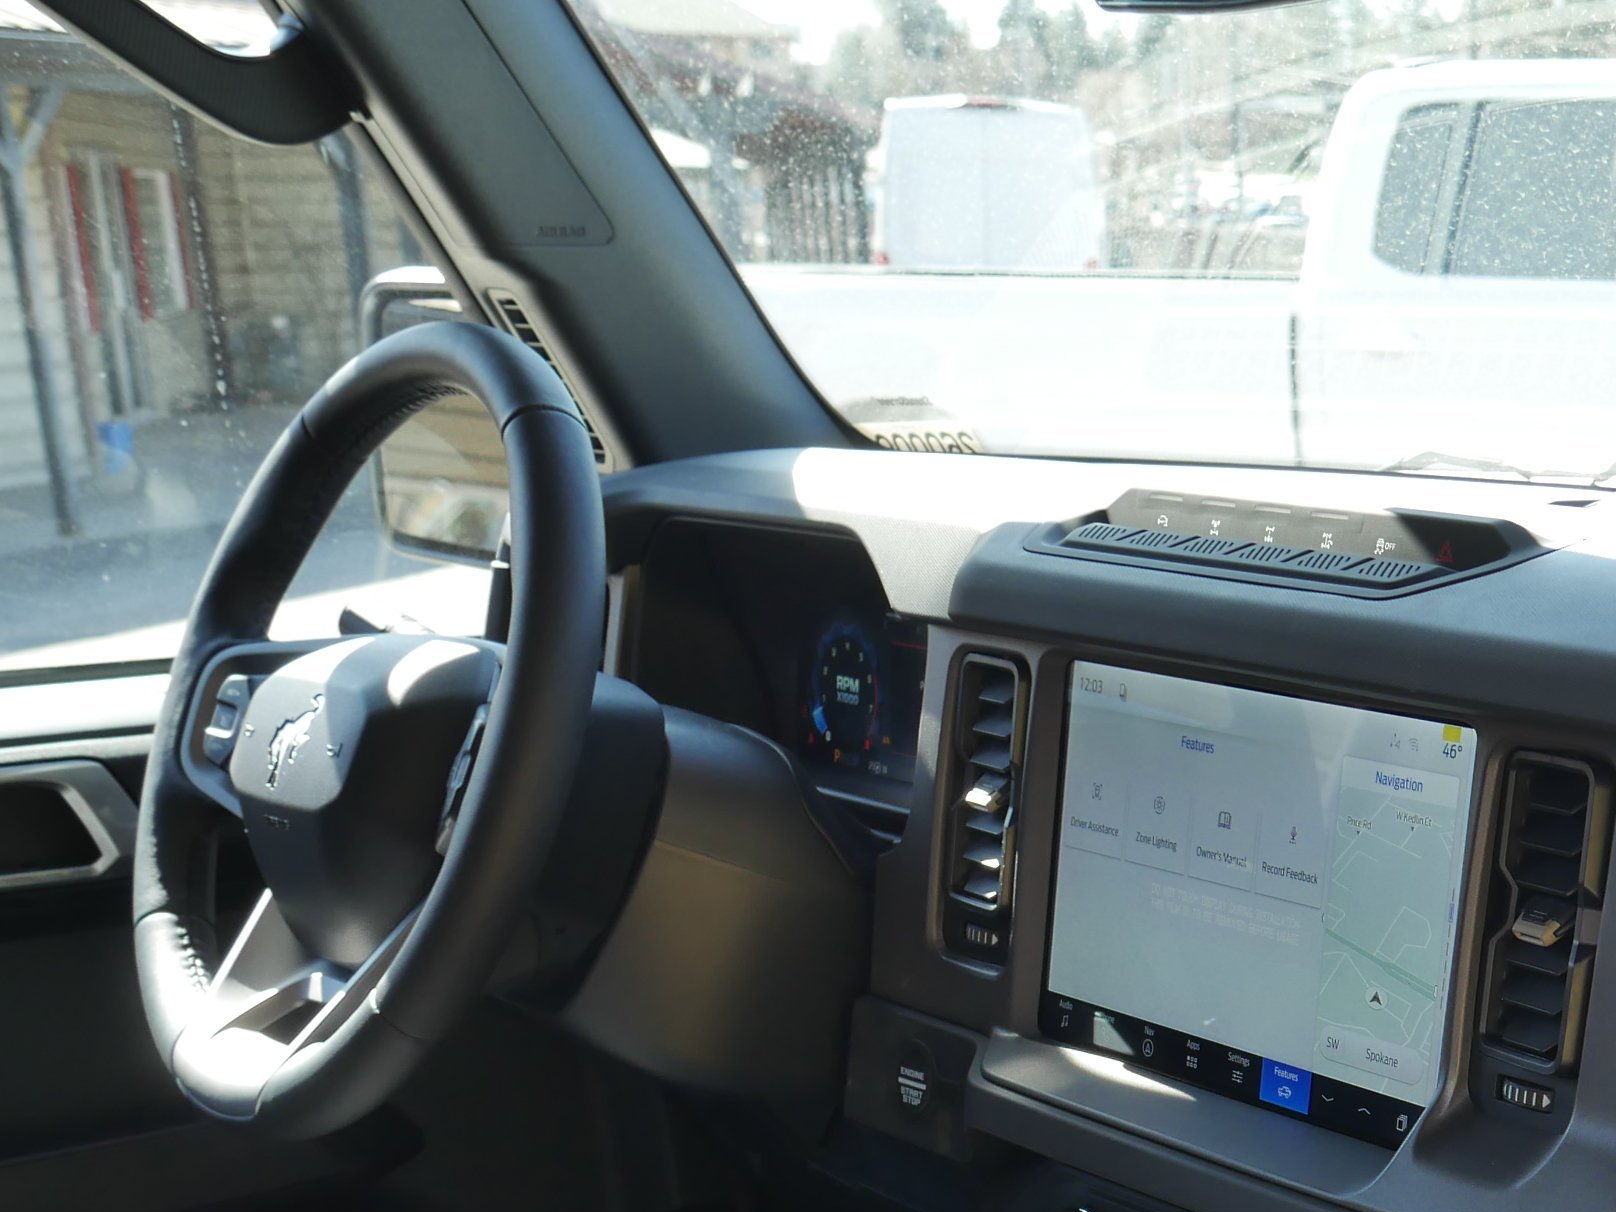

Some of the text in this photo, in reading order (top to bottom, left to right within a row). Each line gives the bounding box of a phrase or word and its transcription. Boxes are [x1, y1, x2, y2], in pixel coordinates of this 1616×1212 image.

[1385, 541, 1396, 552] OFF
[836, 674, 860, 694] RPM
[1080, 678, 1103, 694] 12:03
[836, 691, 860, 706] X1000
[1181, 735, 1215, 754] Features
[1375, 771, 1423, 792] Navigation
[1396, 811, 1402, 820] W
[1070, 816, 1119, 837] Driver Assistance
[1135, 831, 1177, 852] Zone Lighting
[1196, 846, 1248, 868] Owner's Manual
[1261, 861, 1319, 885] Record Feedback
[1059, 999, 1073, 1011] Audio
[1144, 1026, 1155, 1036] Nav
[1186, 1039, 1200, 1052] Apps
[1326, 1037, 1339, 1050] SW
[1228, 1051, 1250, 1068] Settings
[1366, 1048, 1399, 1067] Spokane
[900, 1066, 925, 1081] ENGINE
[1274, 1066, 1299, 1082] Features
[901, 1086, 923, 1098] START
[903, 1097, 921, 1106] STOP
